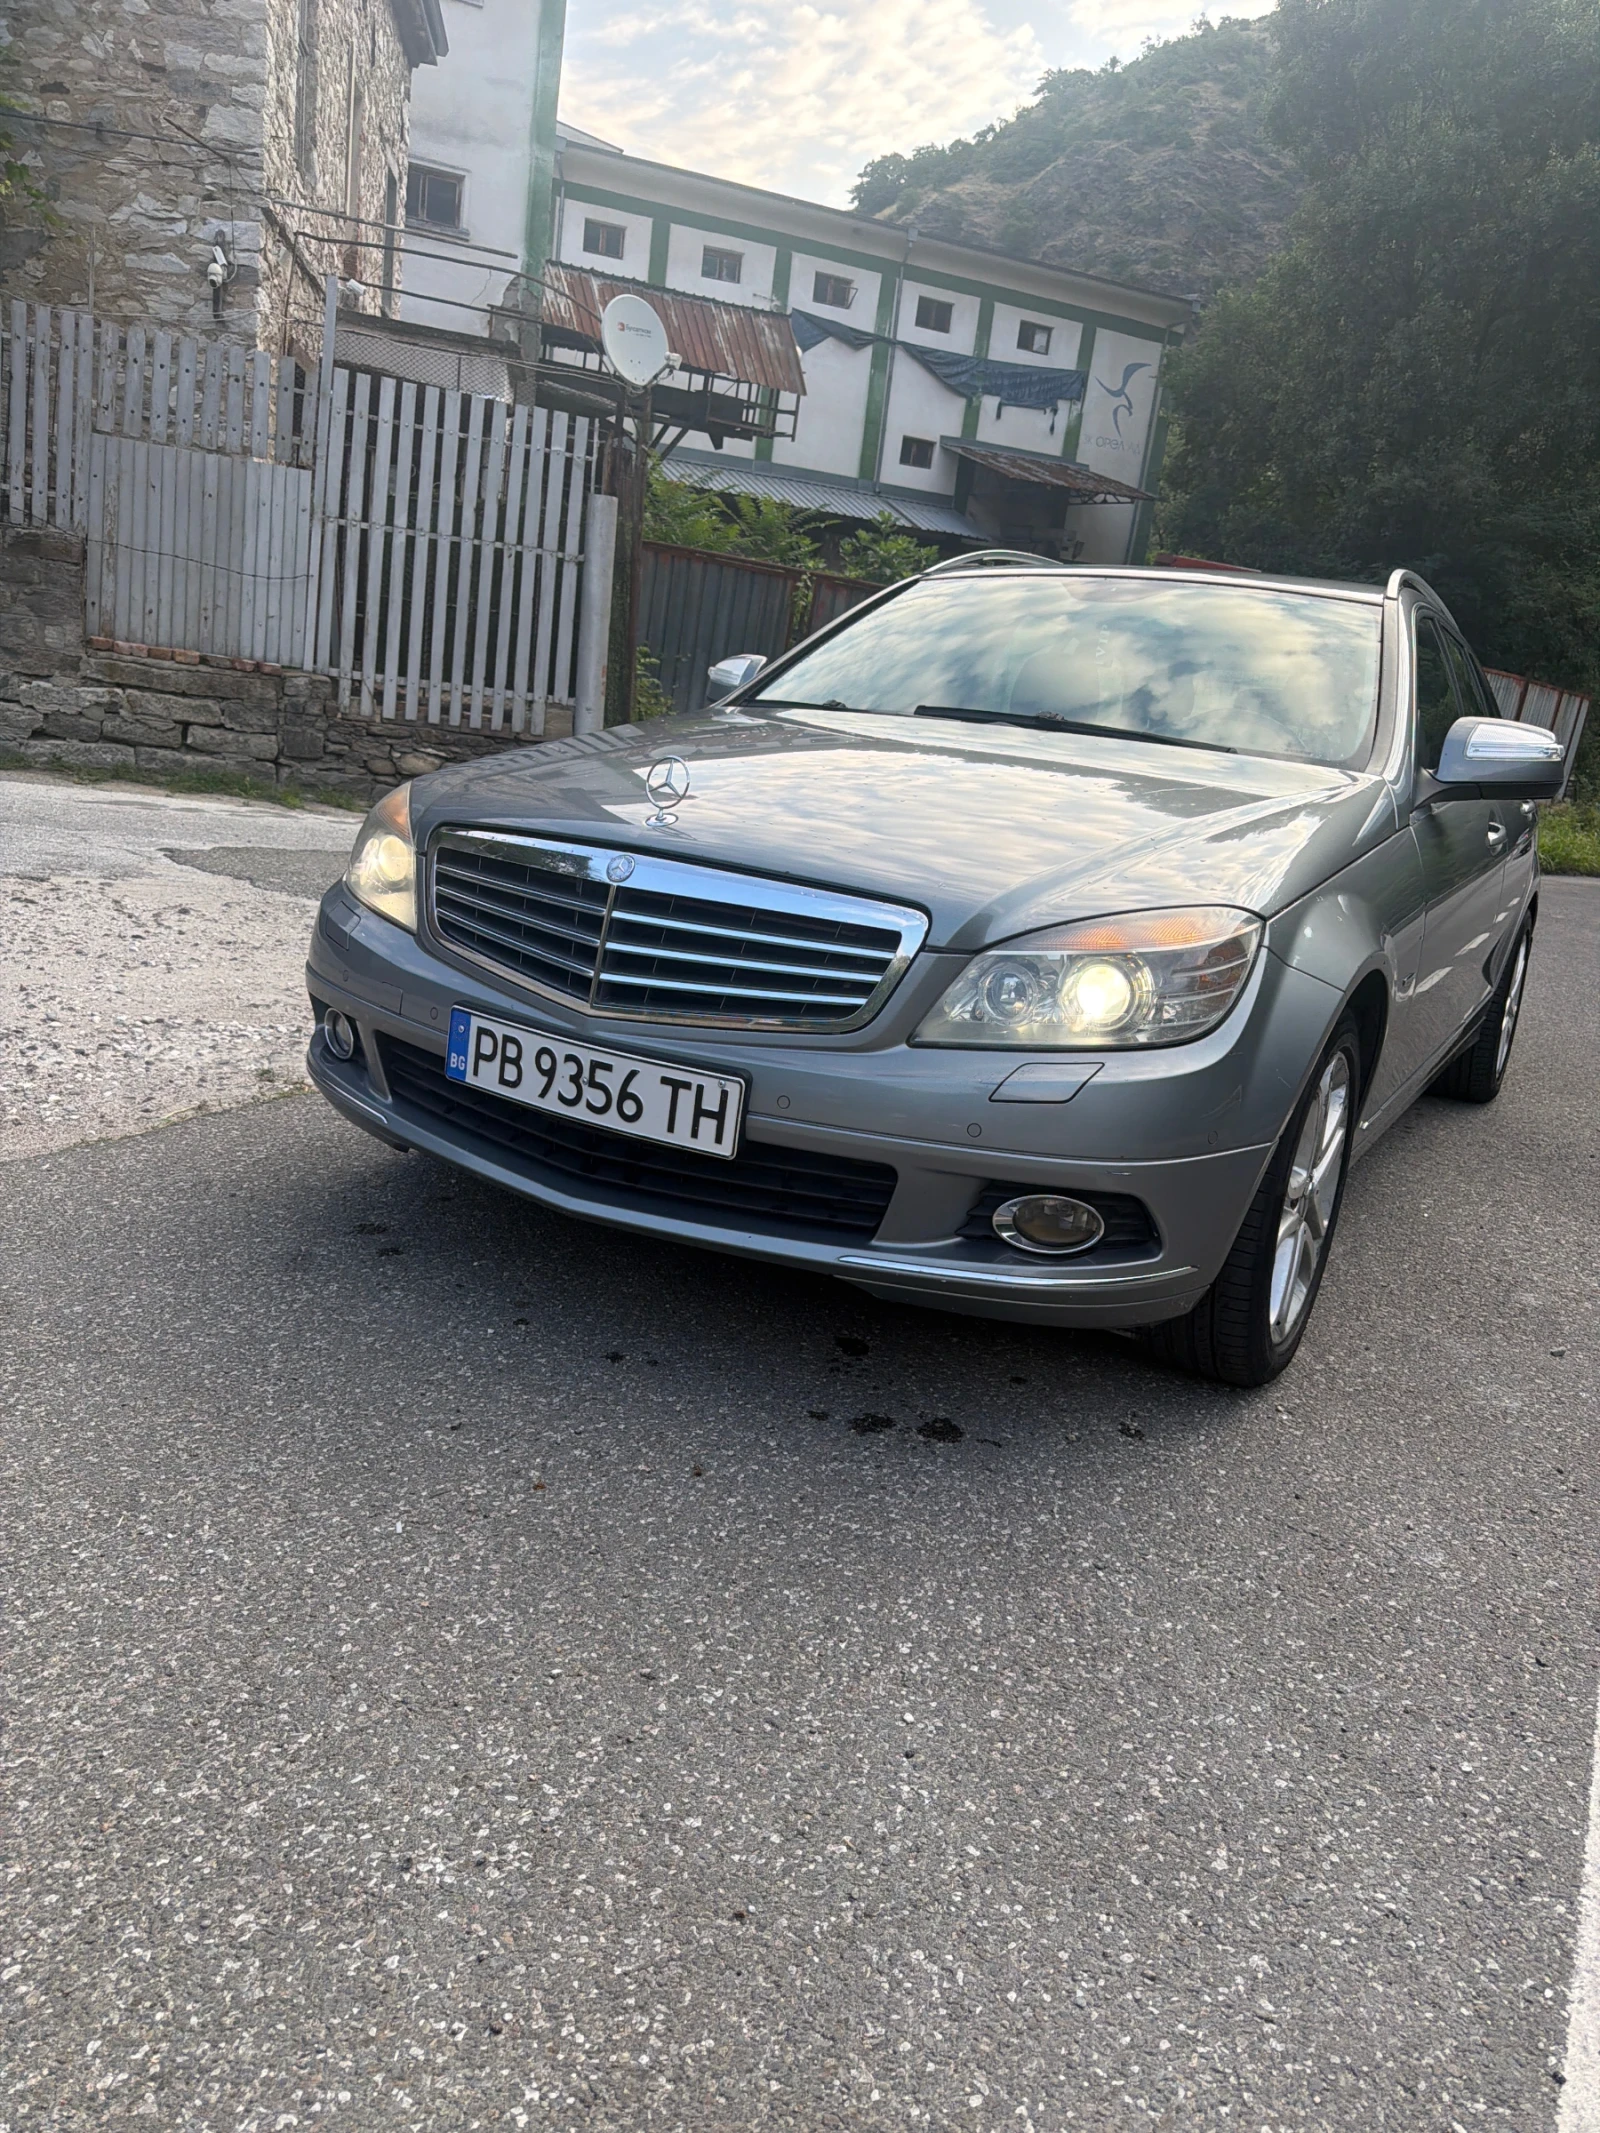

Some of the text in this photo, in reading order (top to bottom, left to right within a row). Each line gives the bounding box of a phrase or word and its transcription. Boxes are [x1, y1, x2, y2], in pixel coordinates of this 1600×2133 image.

[449, 1052, 466, 1071] BG
[472, 1025, 730, 1145] PB 9356 TH
